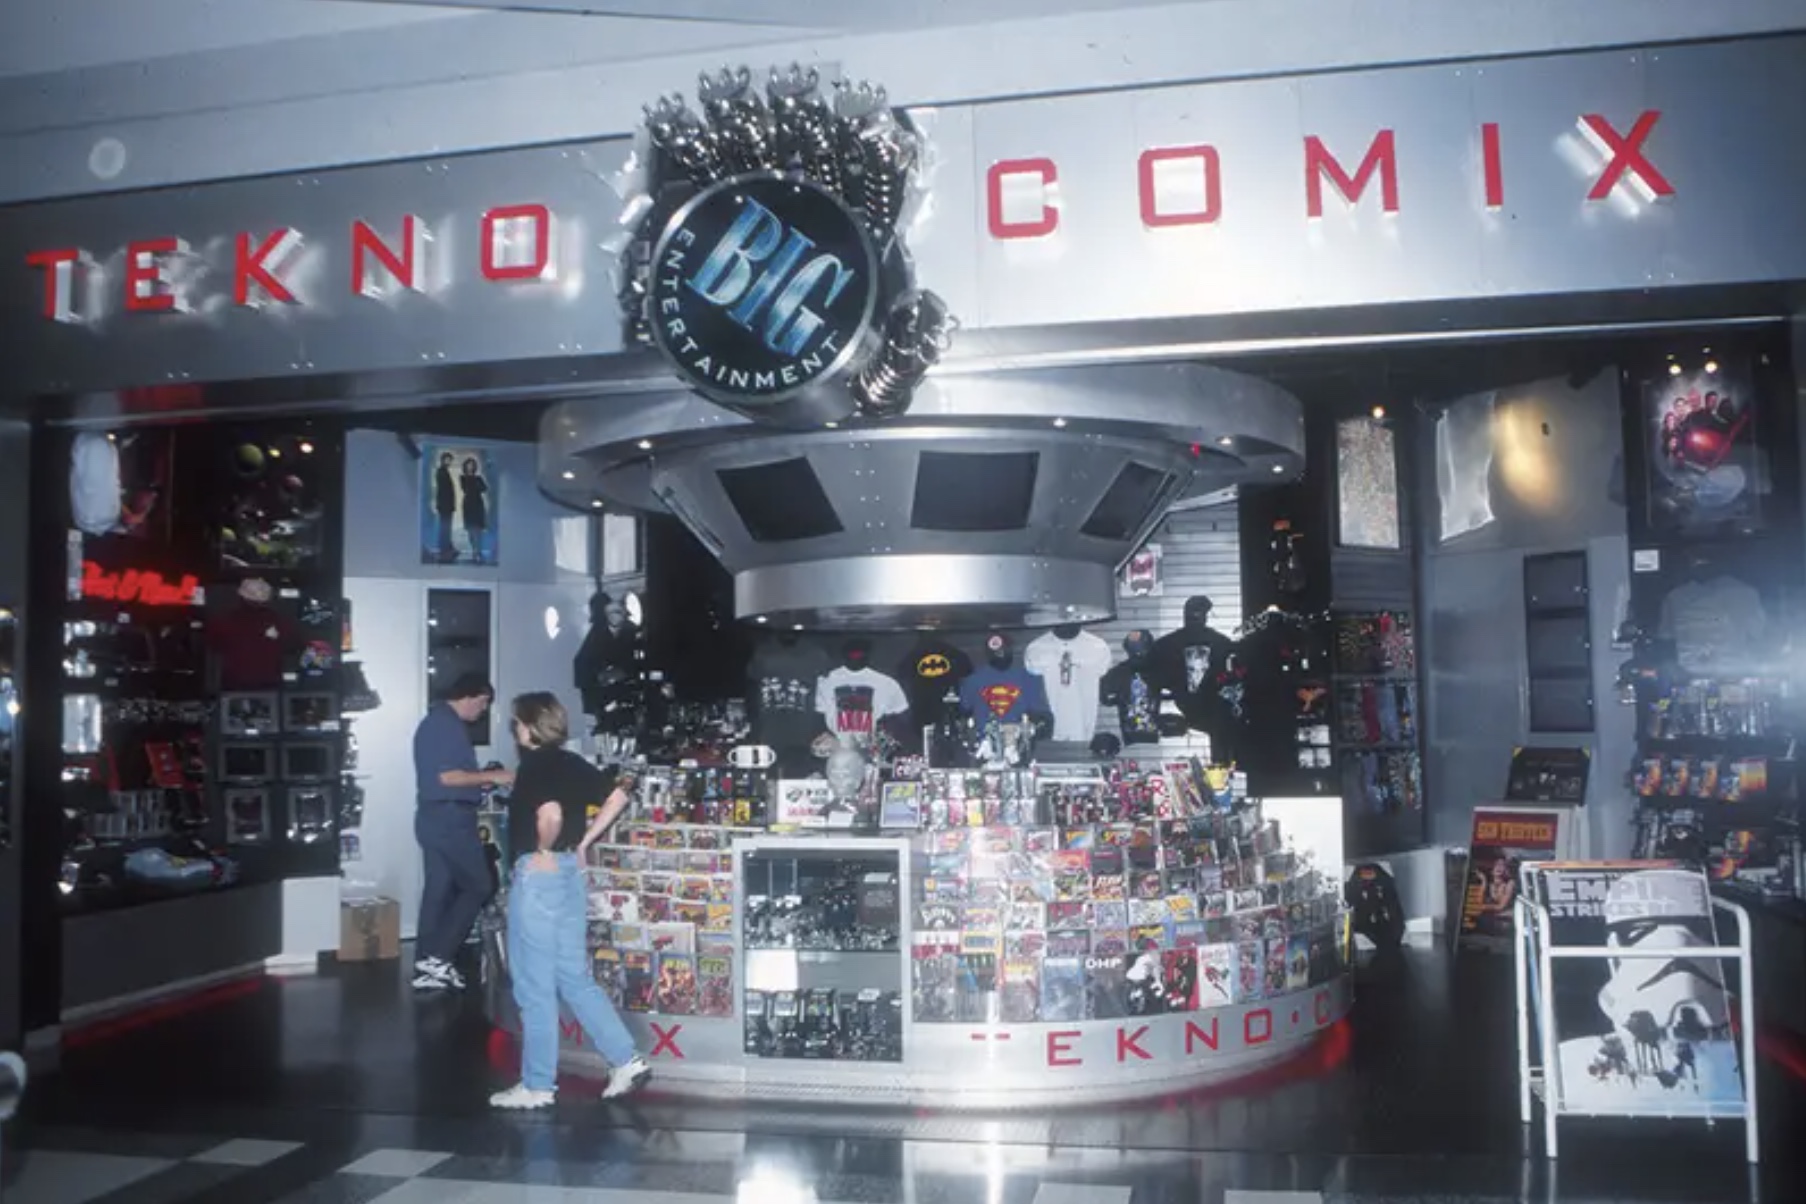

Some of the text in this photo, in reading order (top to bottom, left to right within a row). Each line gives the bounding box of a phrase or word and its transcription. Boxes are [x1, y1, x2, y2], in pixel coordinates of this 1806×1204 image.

[25, 110, 1676, 321] TEKNO COMIX
[685, 196, 855, 356] BIG
[662, 227, 839, 388] ENTERTAINMENT
